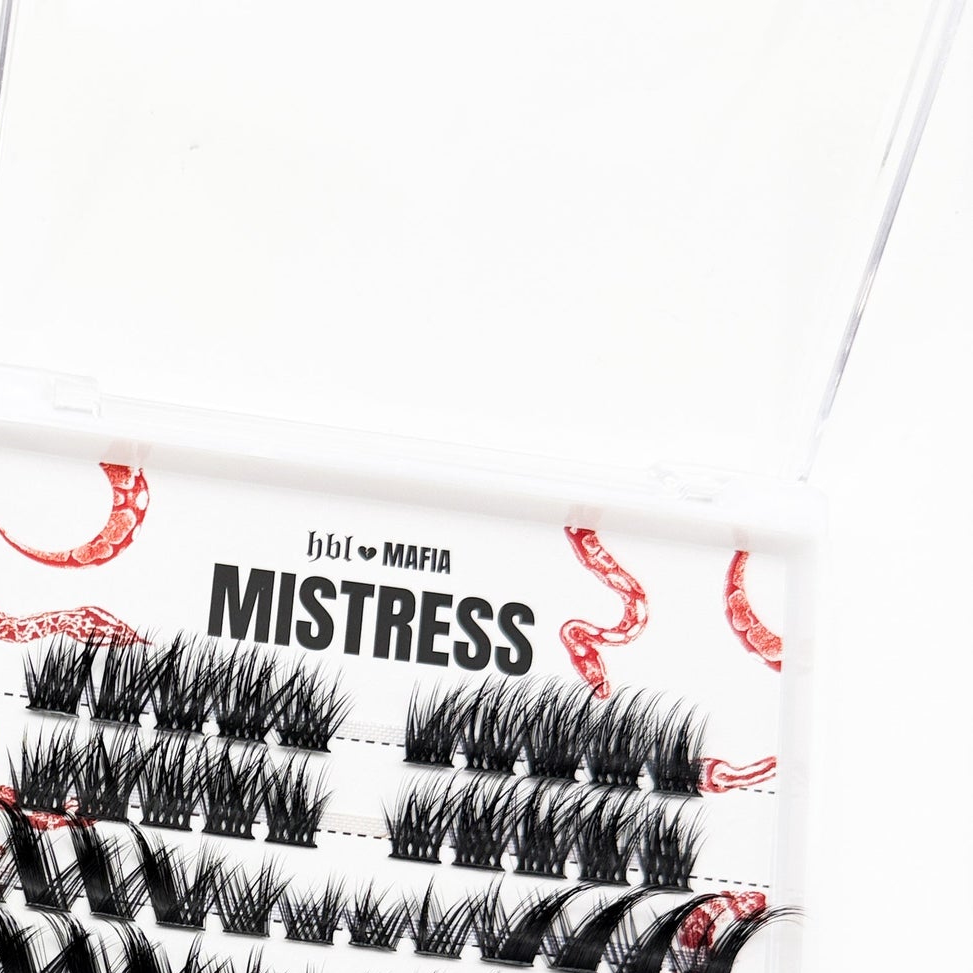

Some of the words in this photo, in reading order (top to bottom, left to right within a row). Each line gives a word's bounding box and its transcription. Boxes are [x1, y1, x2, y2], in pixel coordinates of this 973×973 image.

[307, 530, 353, 562] hbl
[383, 542, 451, 574] MAFIA
[208, 563, 534, 677] MISTRESS
